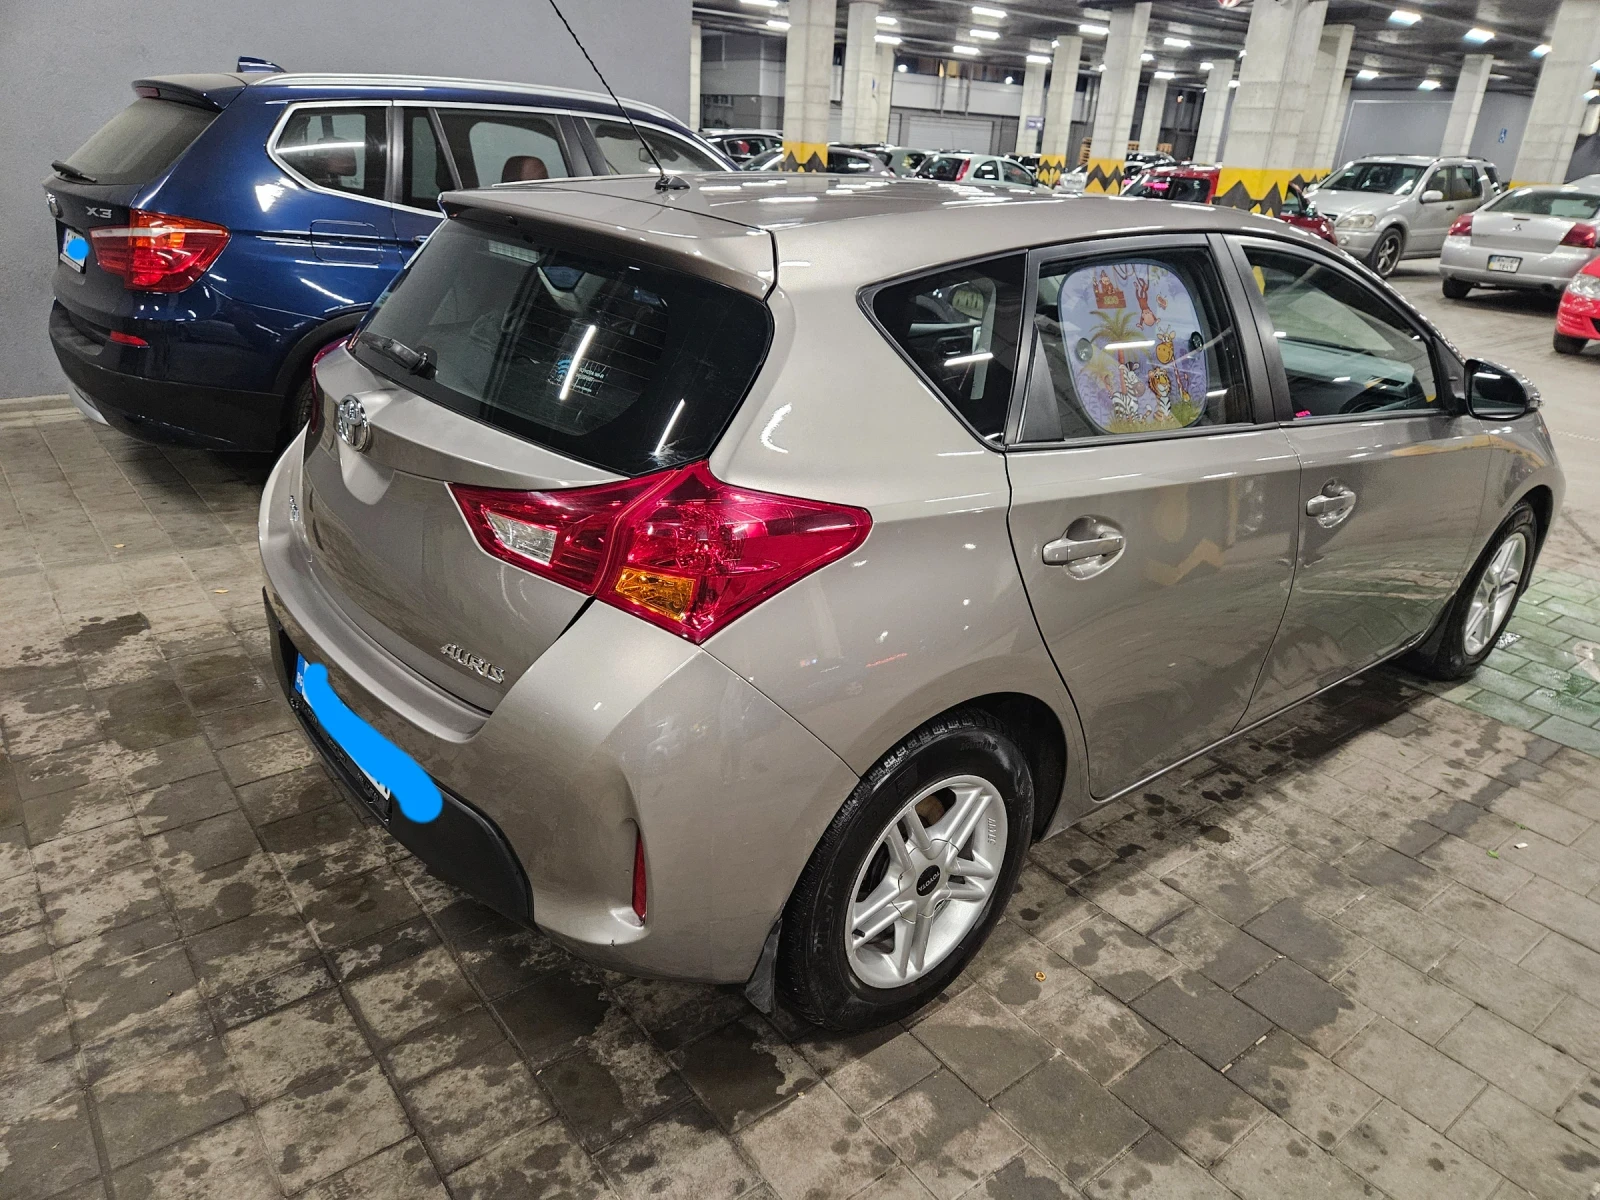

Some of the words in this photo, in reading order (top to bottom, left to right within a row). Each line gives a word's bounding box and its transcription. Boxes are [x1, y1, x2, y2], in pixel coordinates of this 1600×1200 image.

[86, 206, 112, 219] X3
[440, 643, 505, 684] AURIS
[918, 871, 940, 892] TOYOTA
